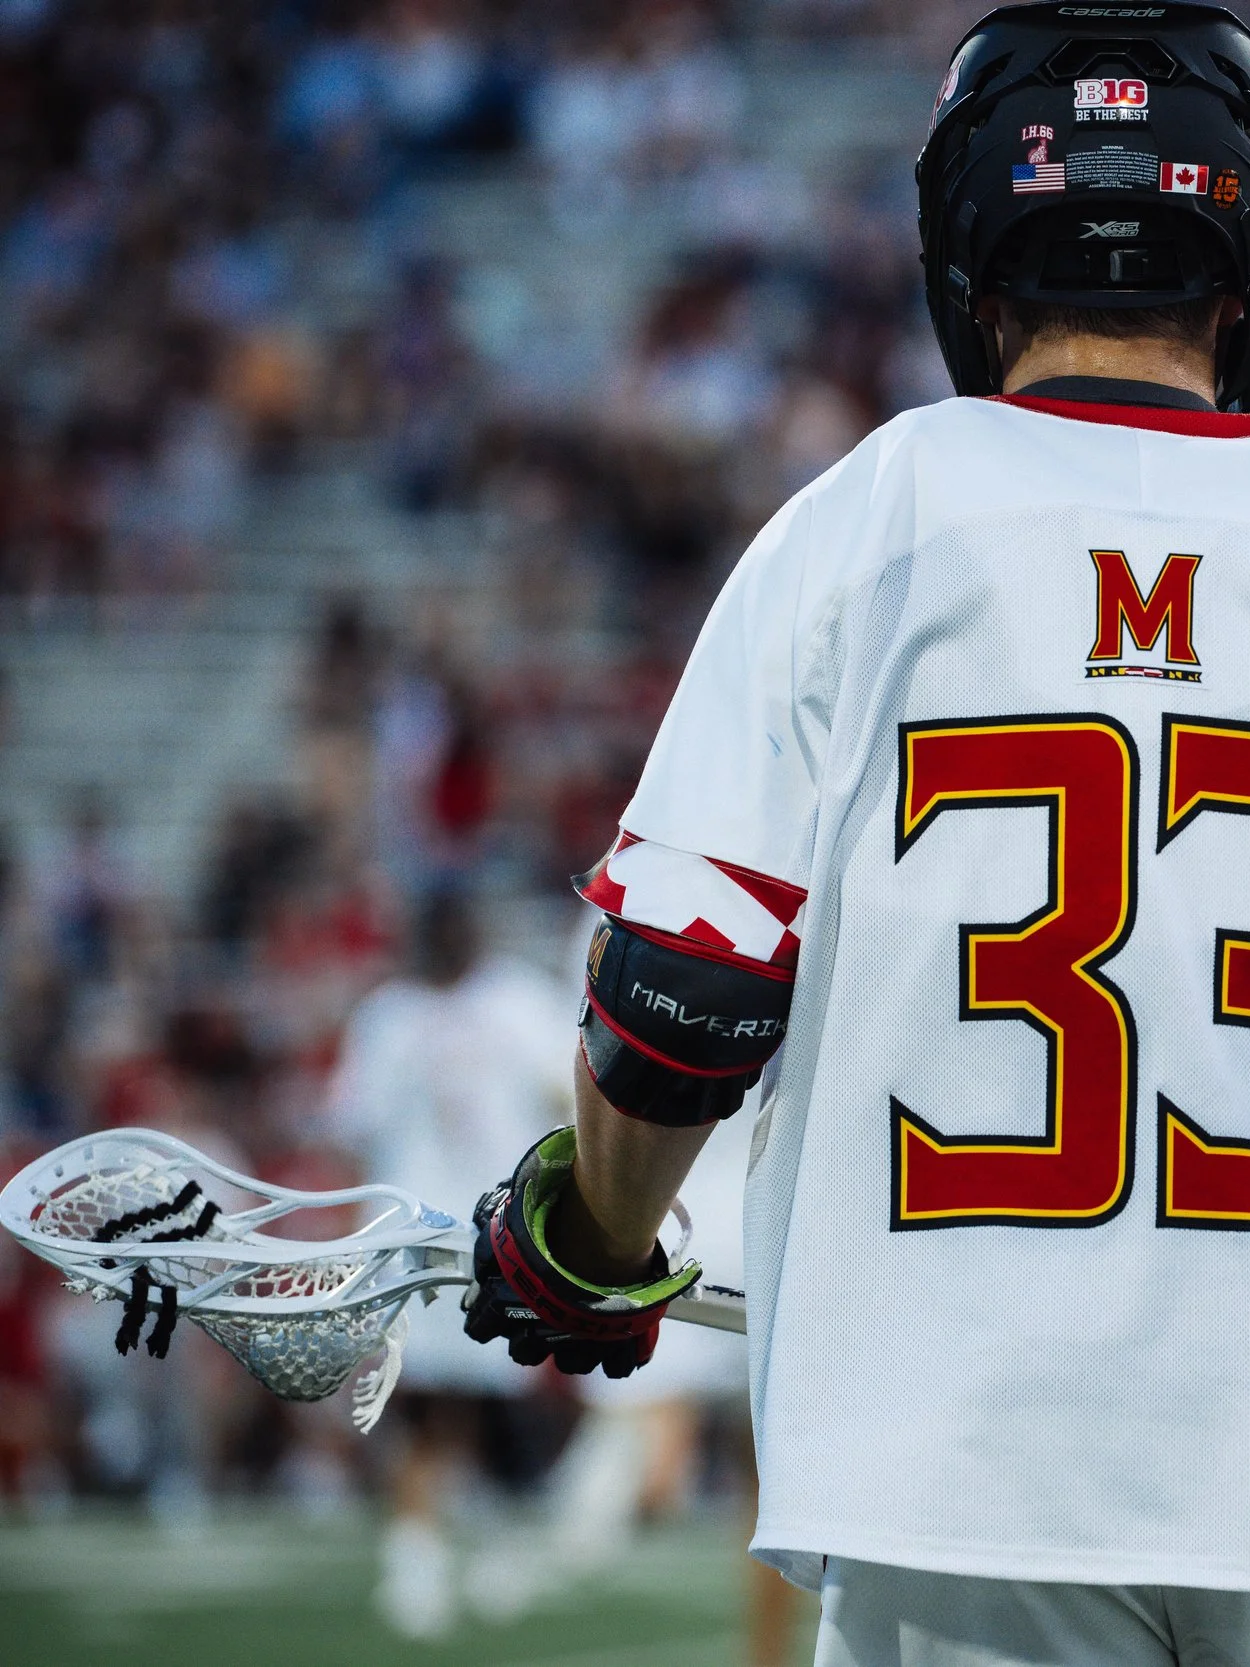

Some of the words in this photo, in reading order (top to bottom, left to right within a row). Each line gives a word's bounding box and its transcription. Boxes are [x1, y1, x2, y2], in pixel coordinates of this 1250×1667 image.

[1058, 7, 1165, 17] cascade
[1076, 109, 1091, 121] BE
[1093, 109, 1117, 121] THE
[1119, 108, 1149, 121] BEST
[1086, 549, 1203, 665] M
